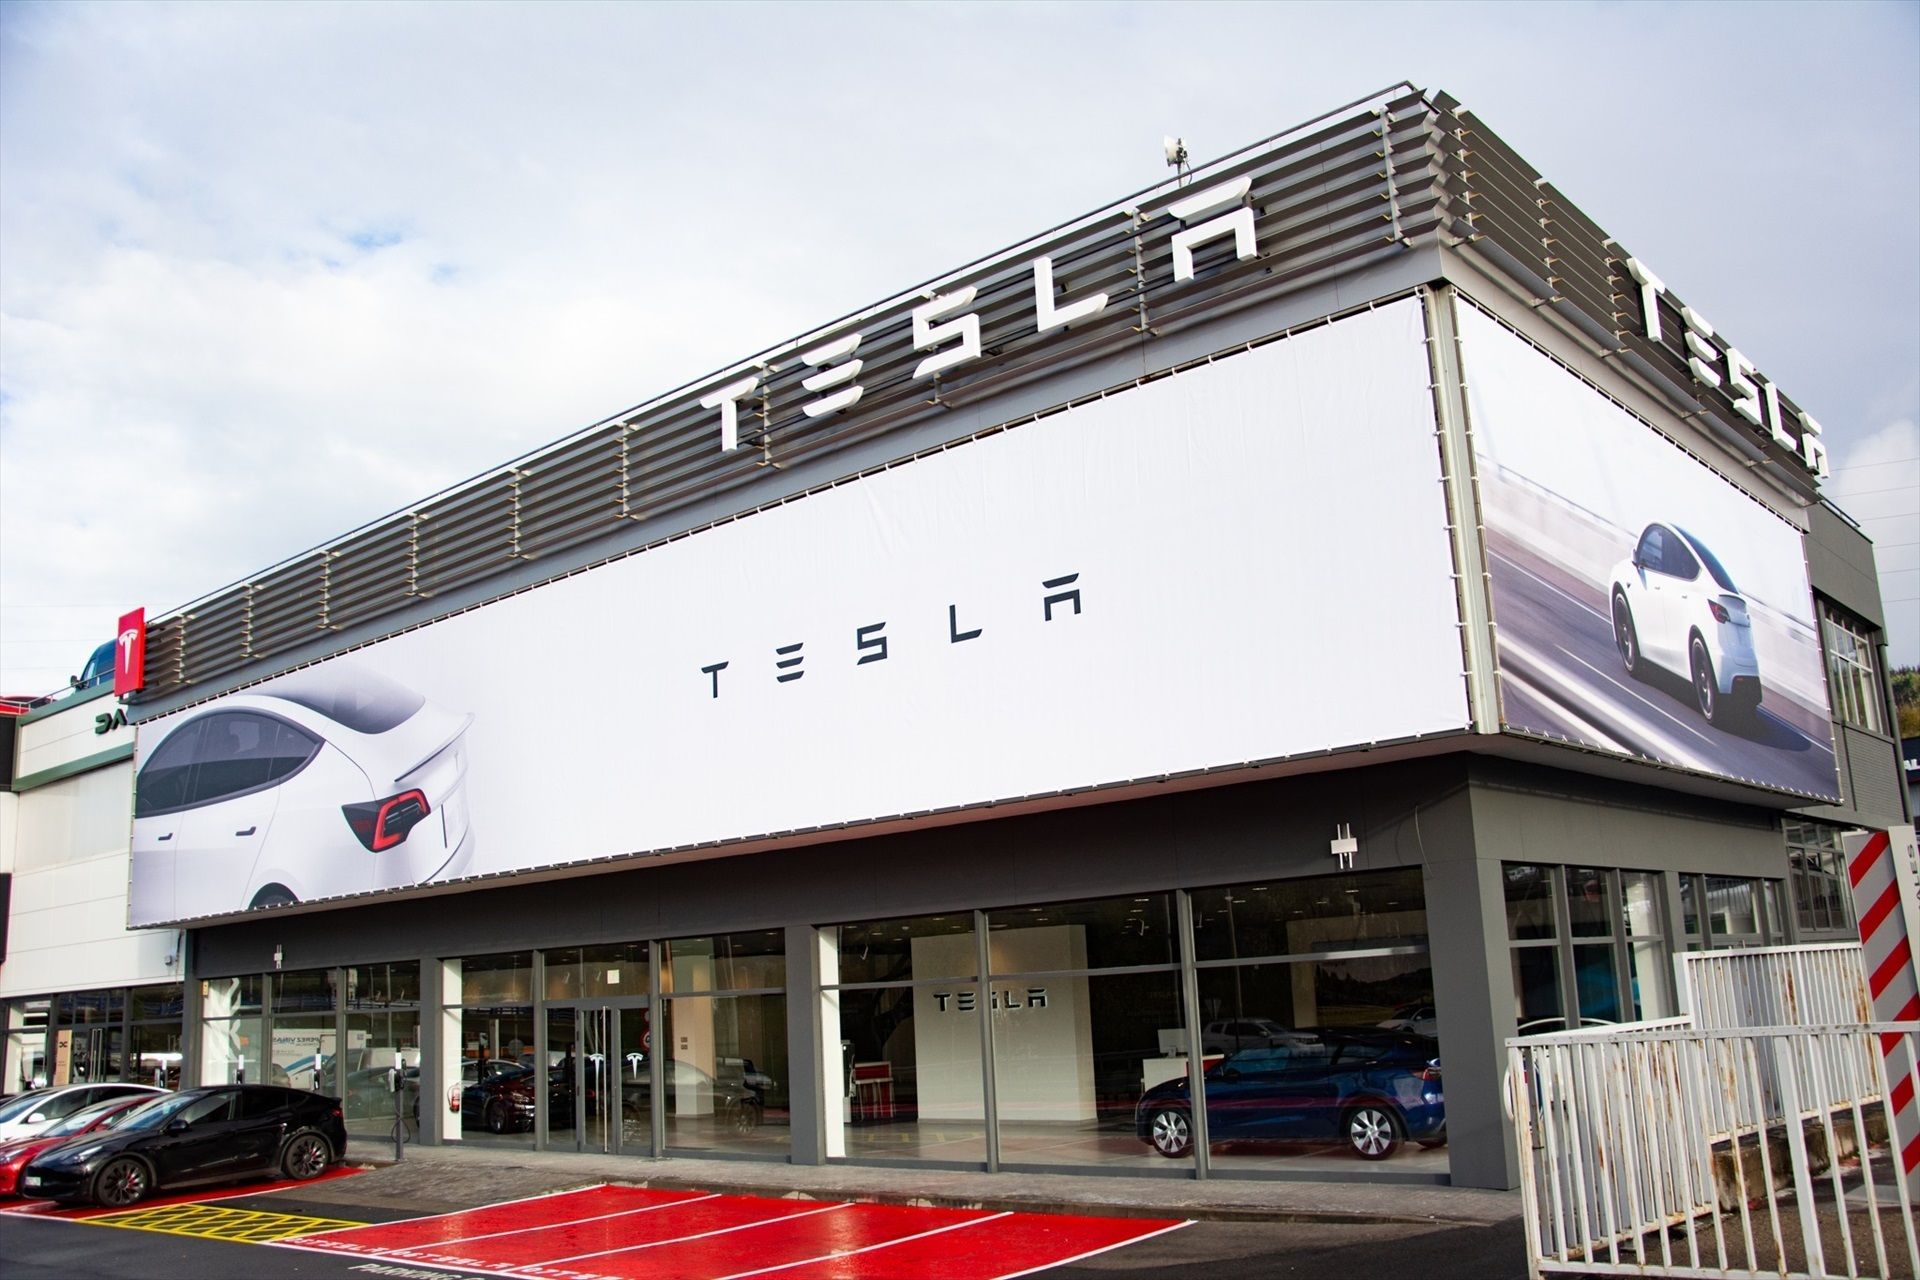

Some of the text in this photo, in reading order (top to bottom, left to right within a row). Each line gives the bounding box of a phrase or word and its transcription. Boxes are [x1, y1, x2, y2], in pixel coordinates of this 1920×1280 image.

[700, 177, 1258, 452] TESLA
[1626, 257, 1829, 479] TESLA
[701, 573, 1081, 699] TESLA
